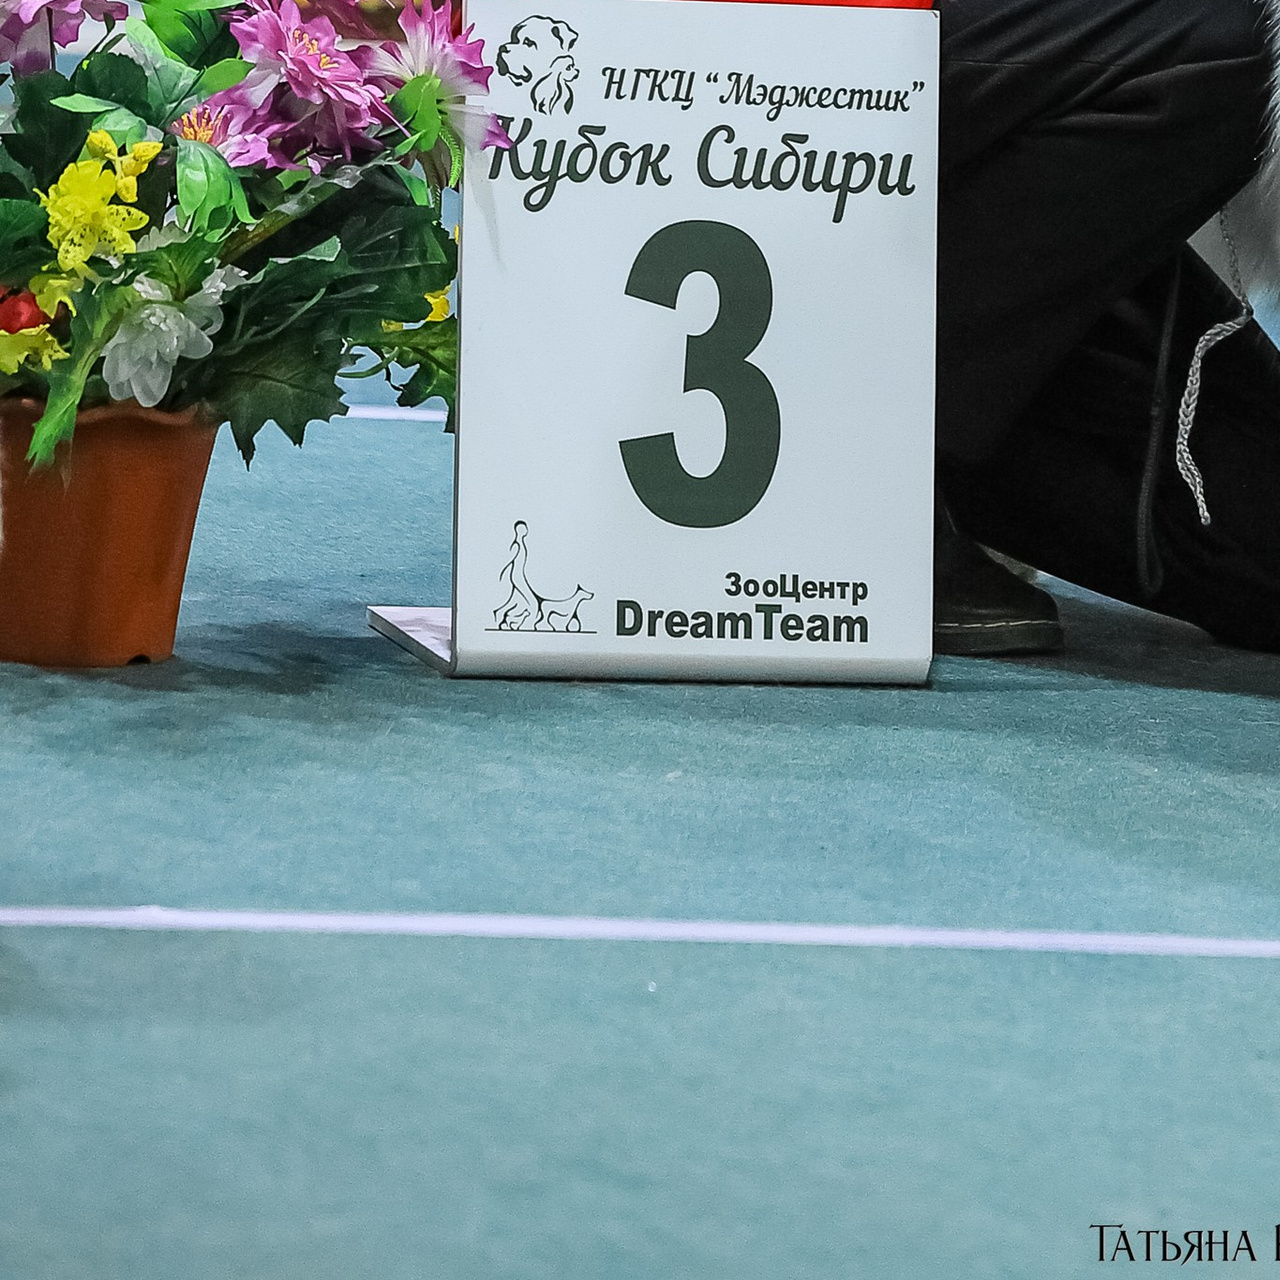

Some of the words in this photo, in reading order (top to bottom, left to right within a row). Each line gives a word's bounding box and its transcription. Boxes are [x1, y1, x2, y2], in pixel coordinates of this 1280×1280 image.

[601, 66, 697, 111] НГКЦ
[488, 114, 673, 213] Кубок
[697, 124, 916, 224] Сибири
[618, 219, 782, 529] 3
[724, 571, 869, 607] ЗооЦентр
[616, 599, 869, 643] DreamTeam
